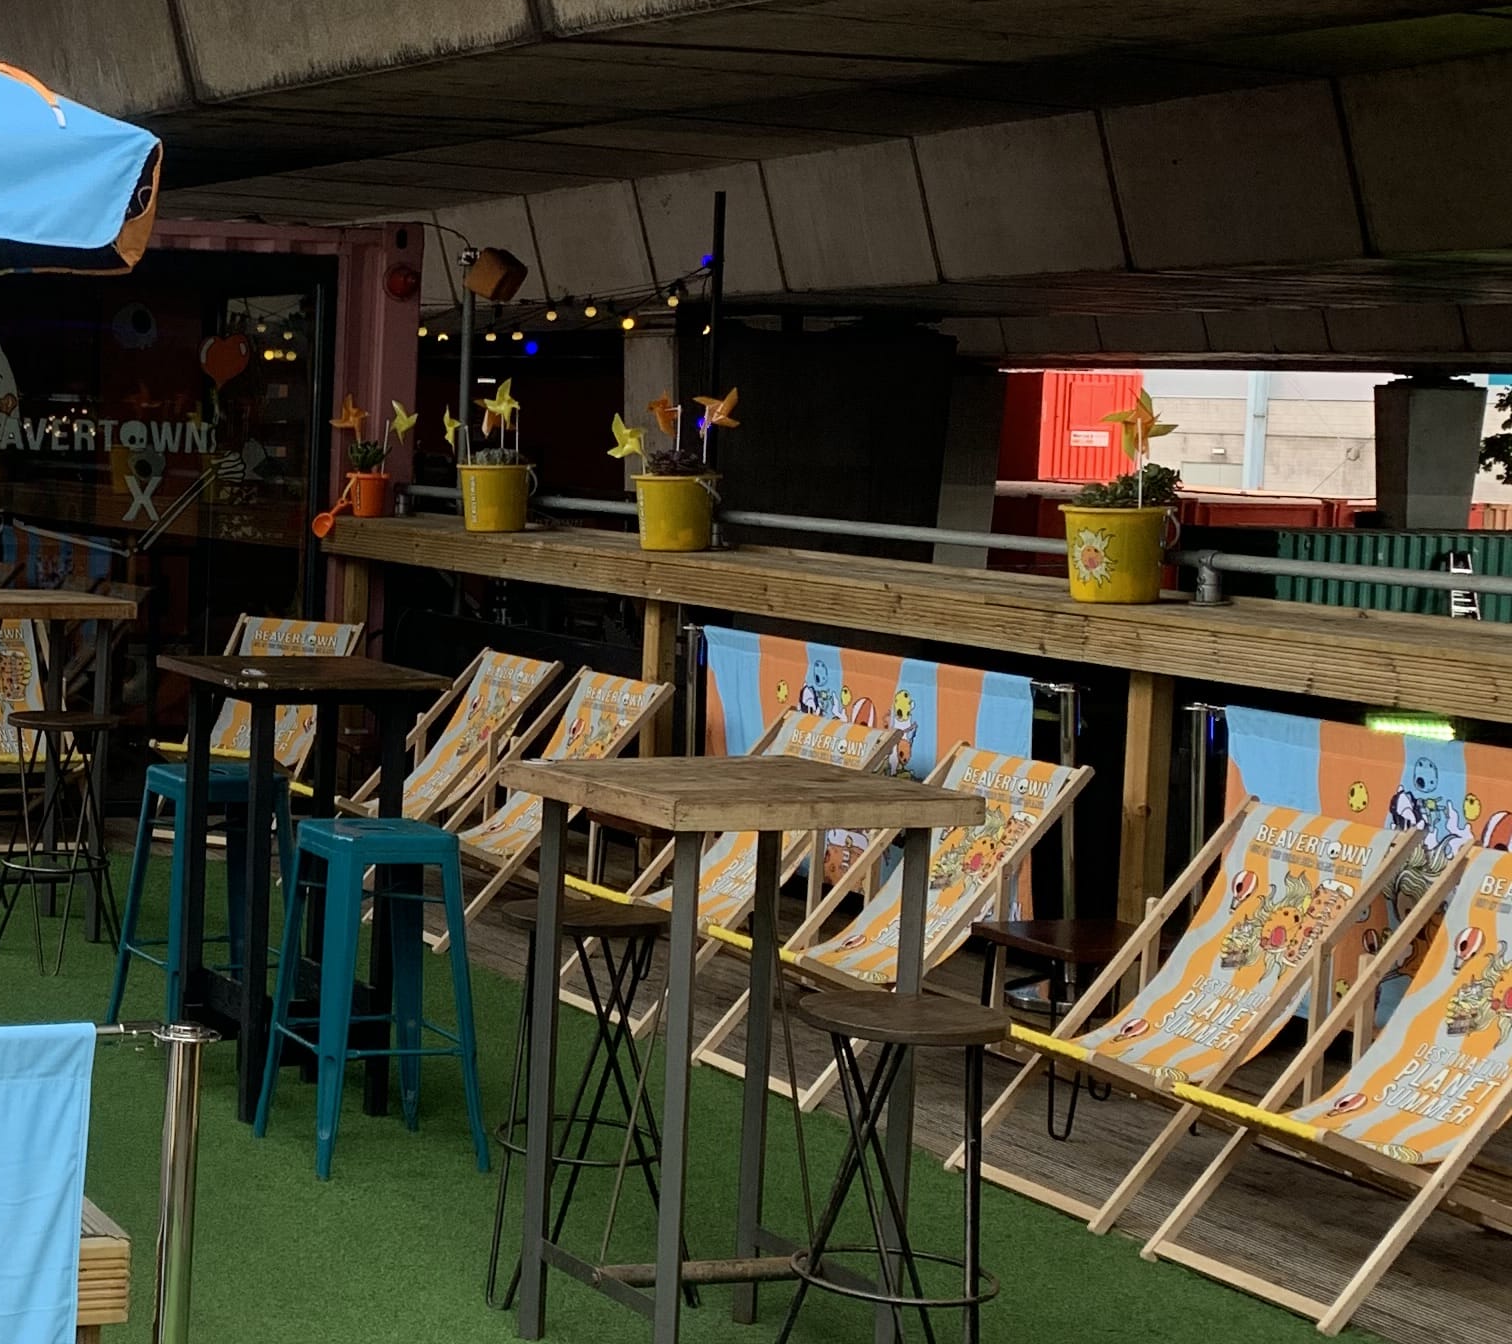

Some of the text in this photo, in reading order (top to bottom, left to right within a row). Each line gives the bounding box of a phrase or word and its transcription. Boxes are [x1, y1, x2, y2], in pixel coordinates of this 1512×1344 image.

[255, 630, 337, 648] BEAVERTOWN
[791, 728, 867, 756] BEAVERTOWN
[963, 766, 1053, 798] BEAVERTOWN
[1256, 824, 1373, 866] BEAVERTOWN
[1394, 1058, 1501, 1103] PLANET
